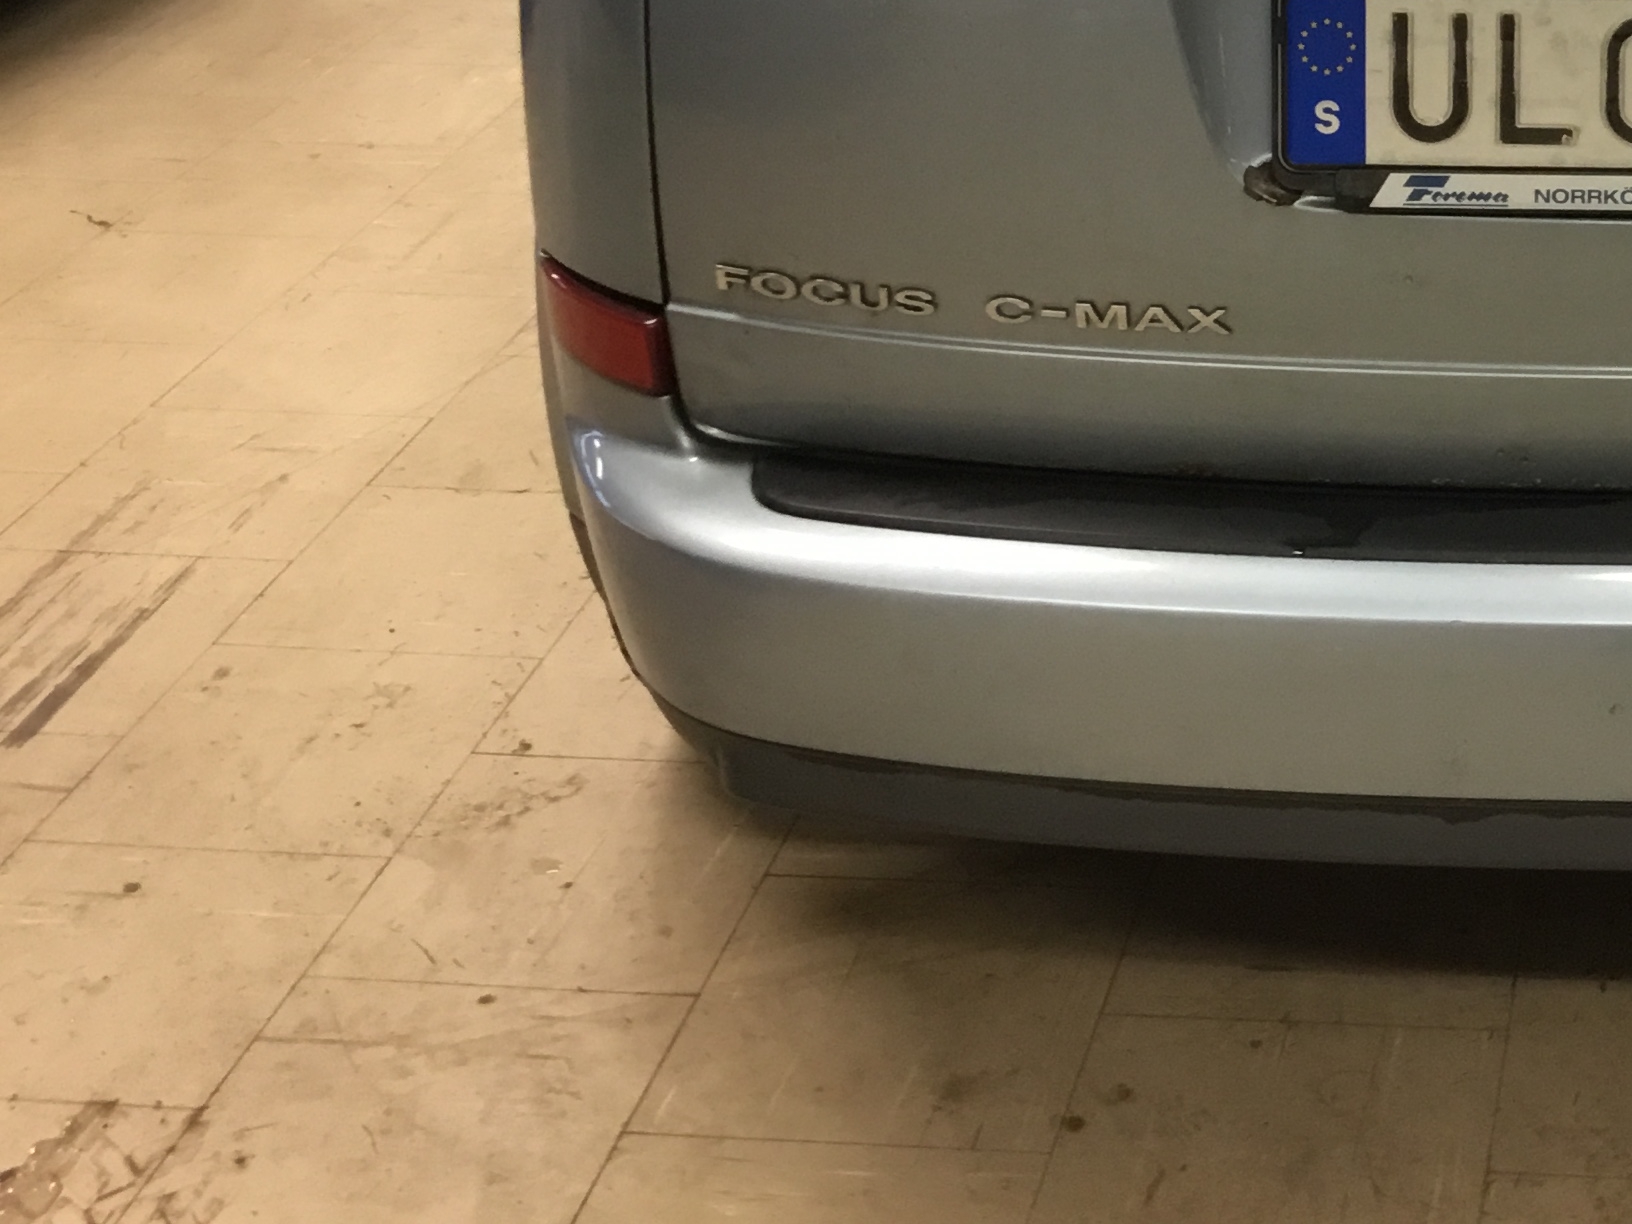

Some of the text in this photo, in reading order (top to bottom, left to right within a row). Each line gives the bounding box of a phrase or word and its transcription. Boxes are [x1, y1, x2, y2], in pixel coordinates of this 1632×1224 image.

[1314, 99, 1341, 135] S
[714, 263, 1234, 336] FOCUS C-MAX
